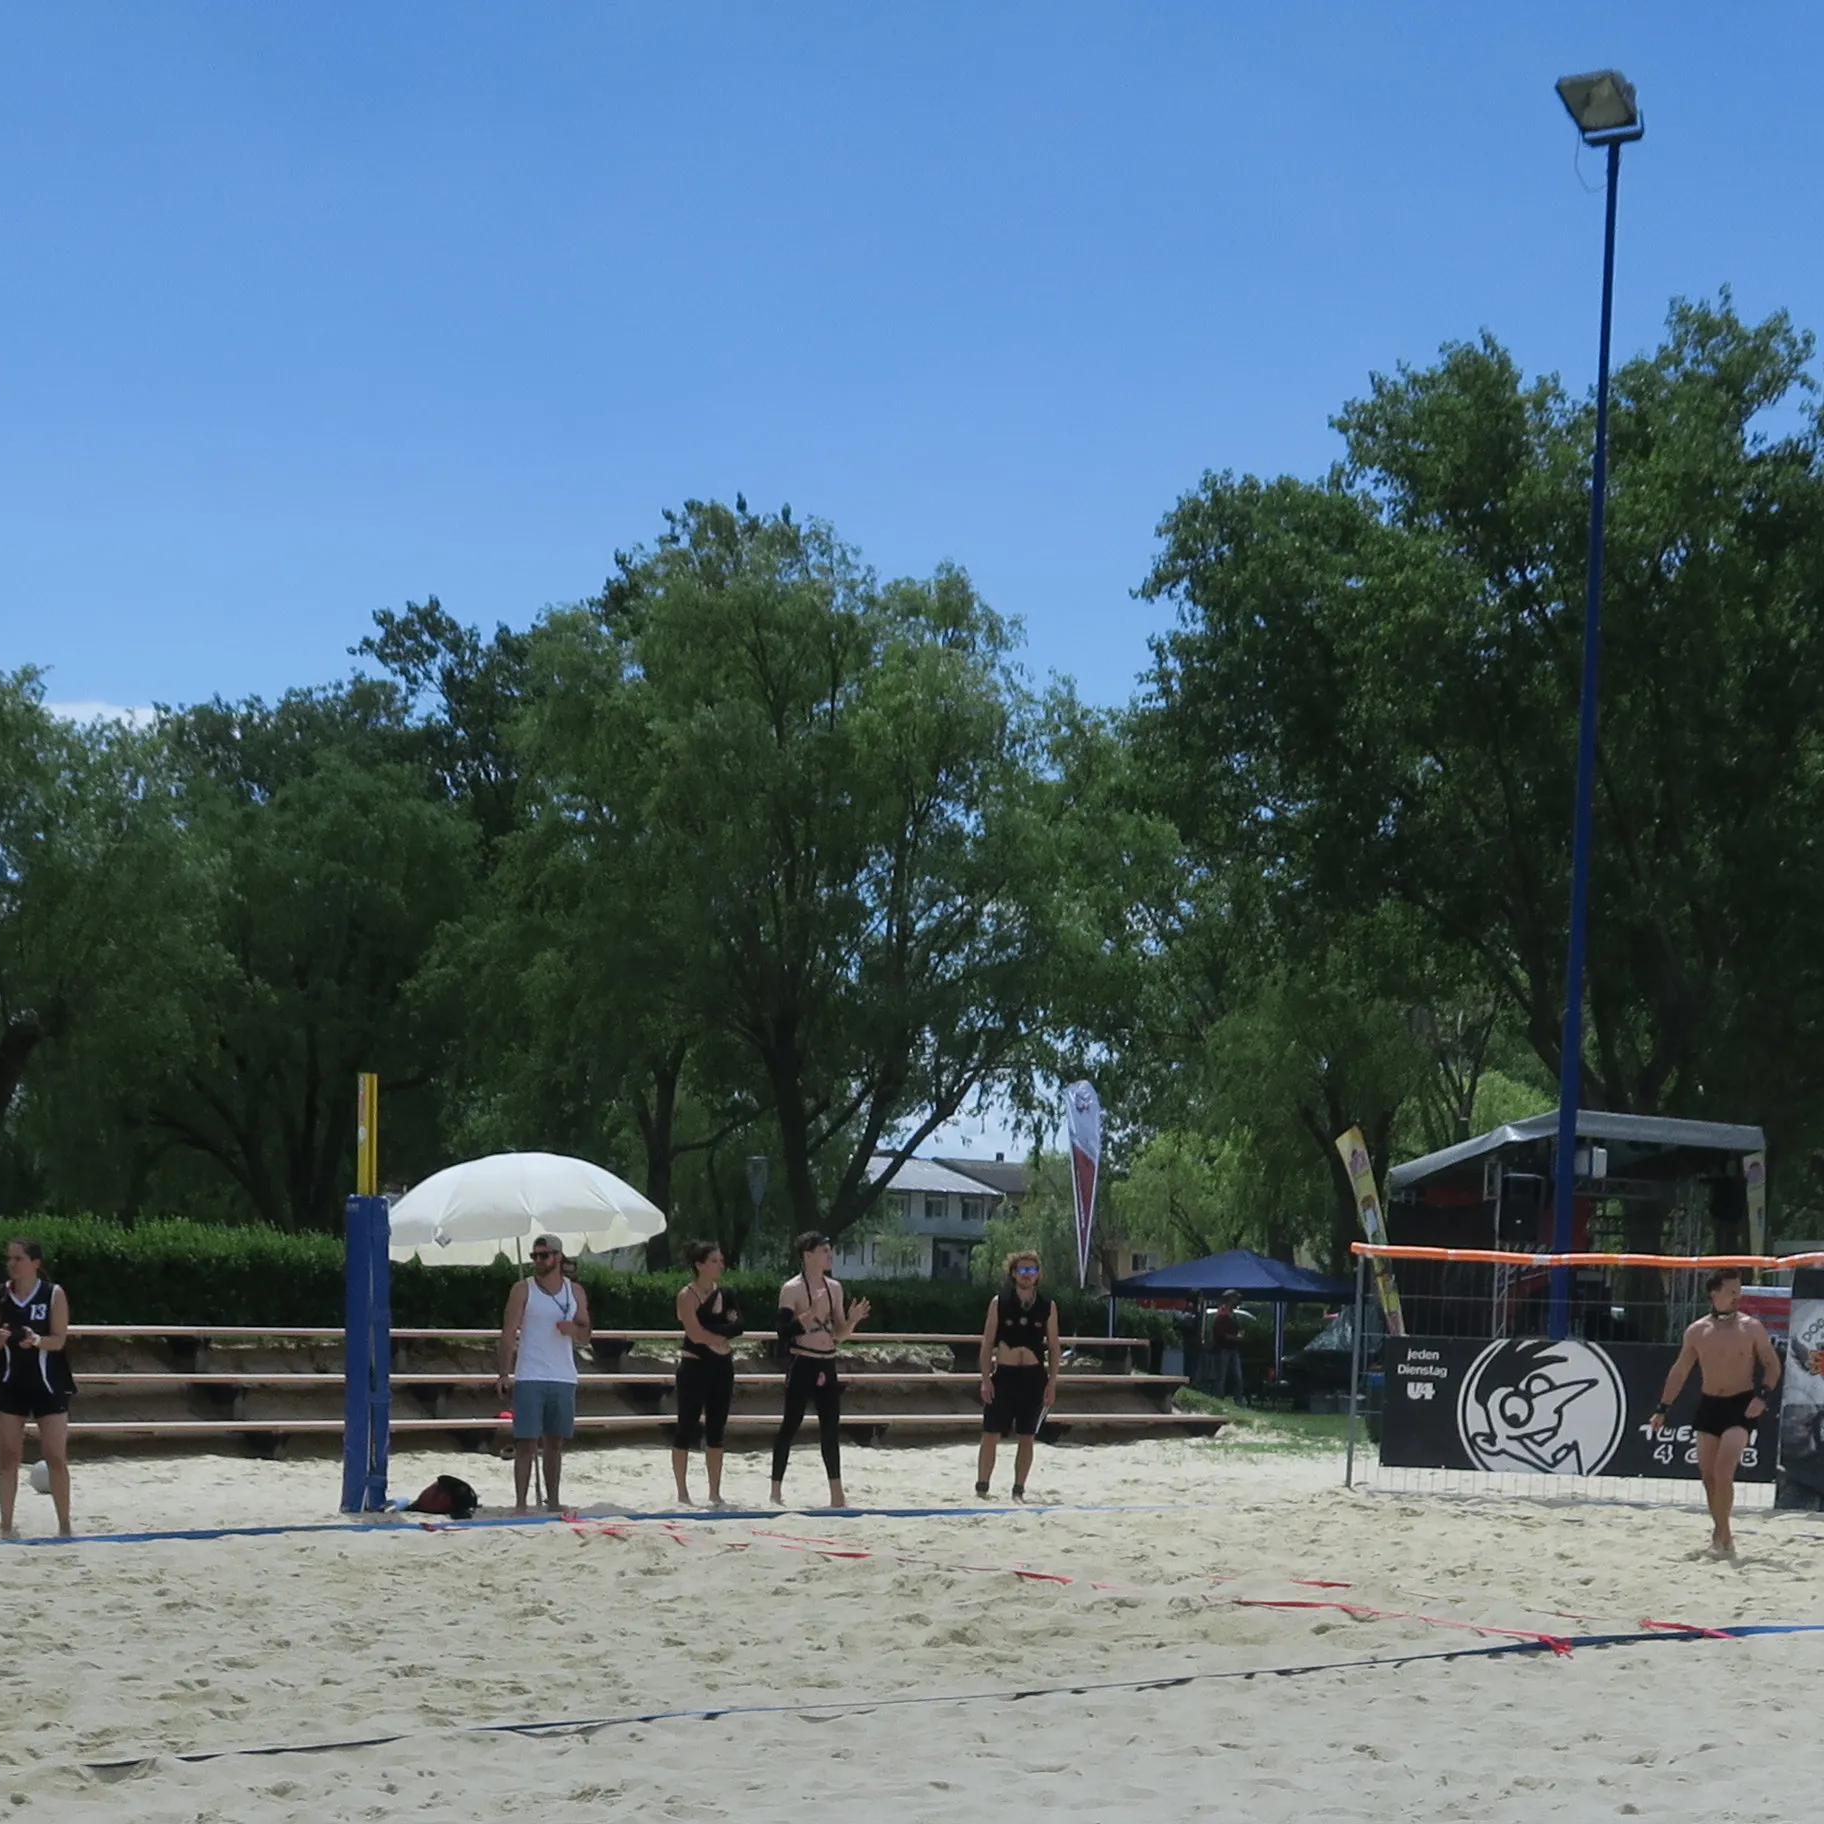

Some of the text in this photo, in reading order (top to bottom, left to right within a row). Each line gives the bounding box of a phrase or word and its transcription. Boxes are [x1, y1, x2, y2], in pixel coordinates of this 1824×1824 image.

[29, 1303, 48, 1322] 13
[1407, 1348, 1440, 1361] jeden
[1397, 1364, 1448, 1378] Dienstag
[1653, 1444, 1674, 1465] 4
